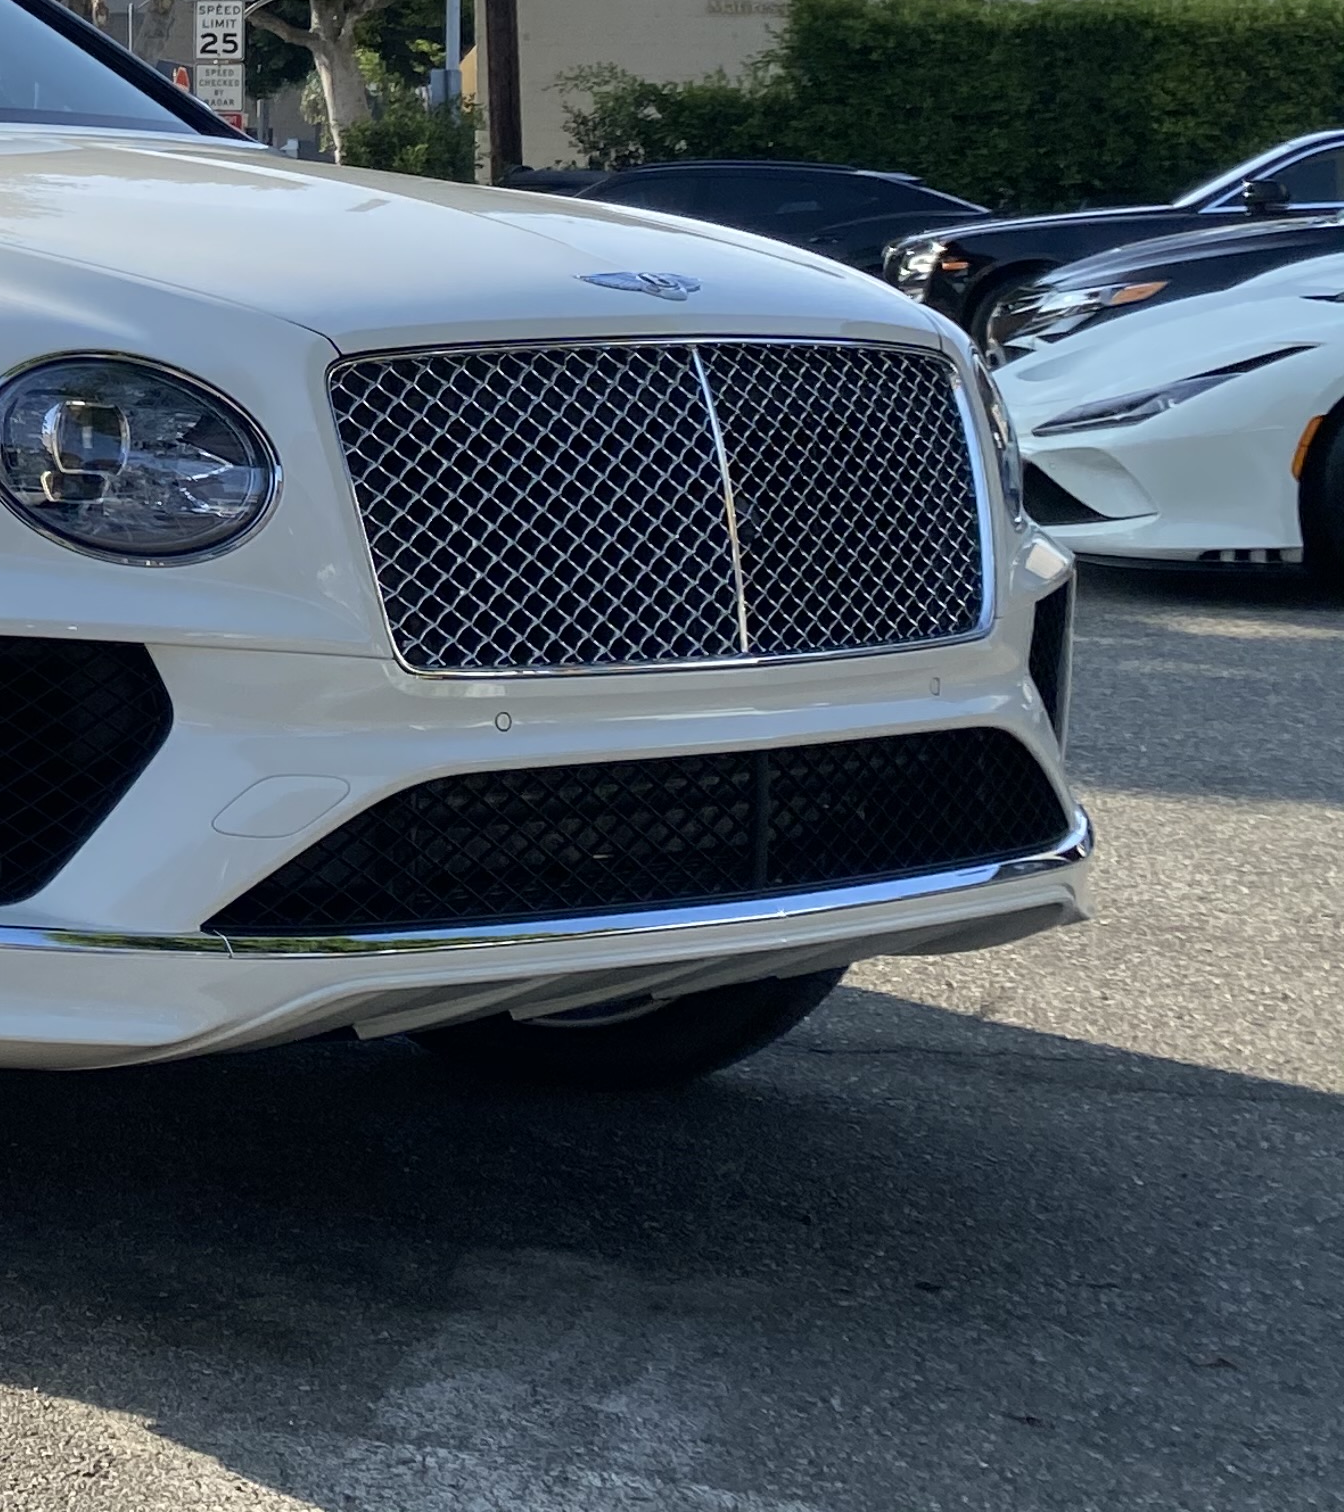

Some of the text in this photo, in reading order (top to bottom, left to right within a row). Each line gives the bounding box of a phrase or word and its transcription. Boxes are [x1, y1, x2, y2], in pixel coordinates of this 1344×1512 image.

[199, 5, 241, 16] SPEED
[202, 19, 237, 29] LIMIT
[200, 32, 239, 54] 25
[205, 68, 234, 77] SPEED
[198, 79, 240, 87] CHECKED
